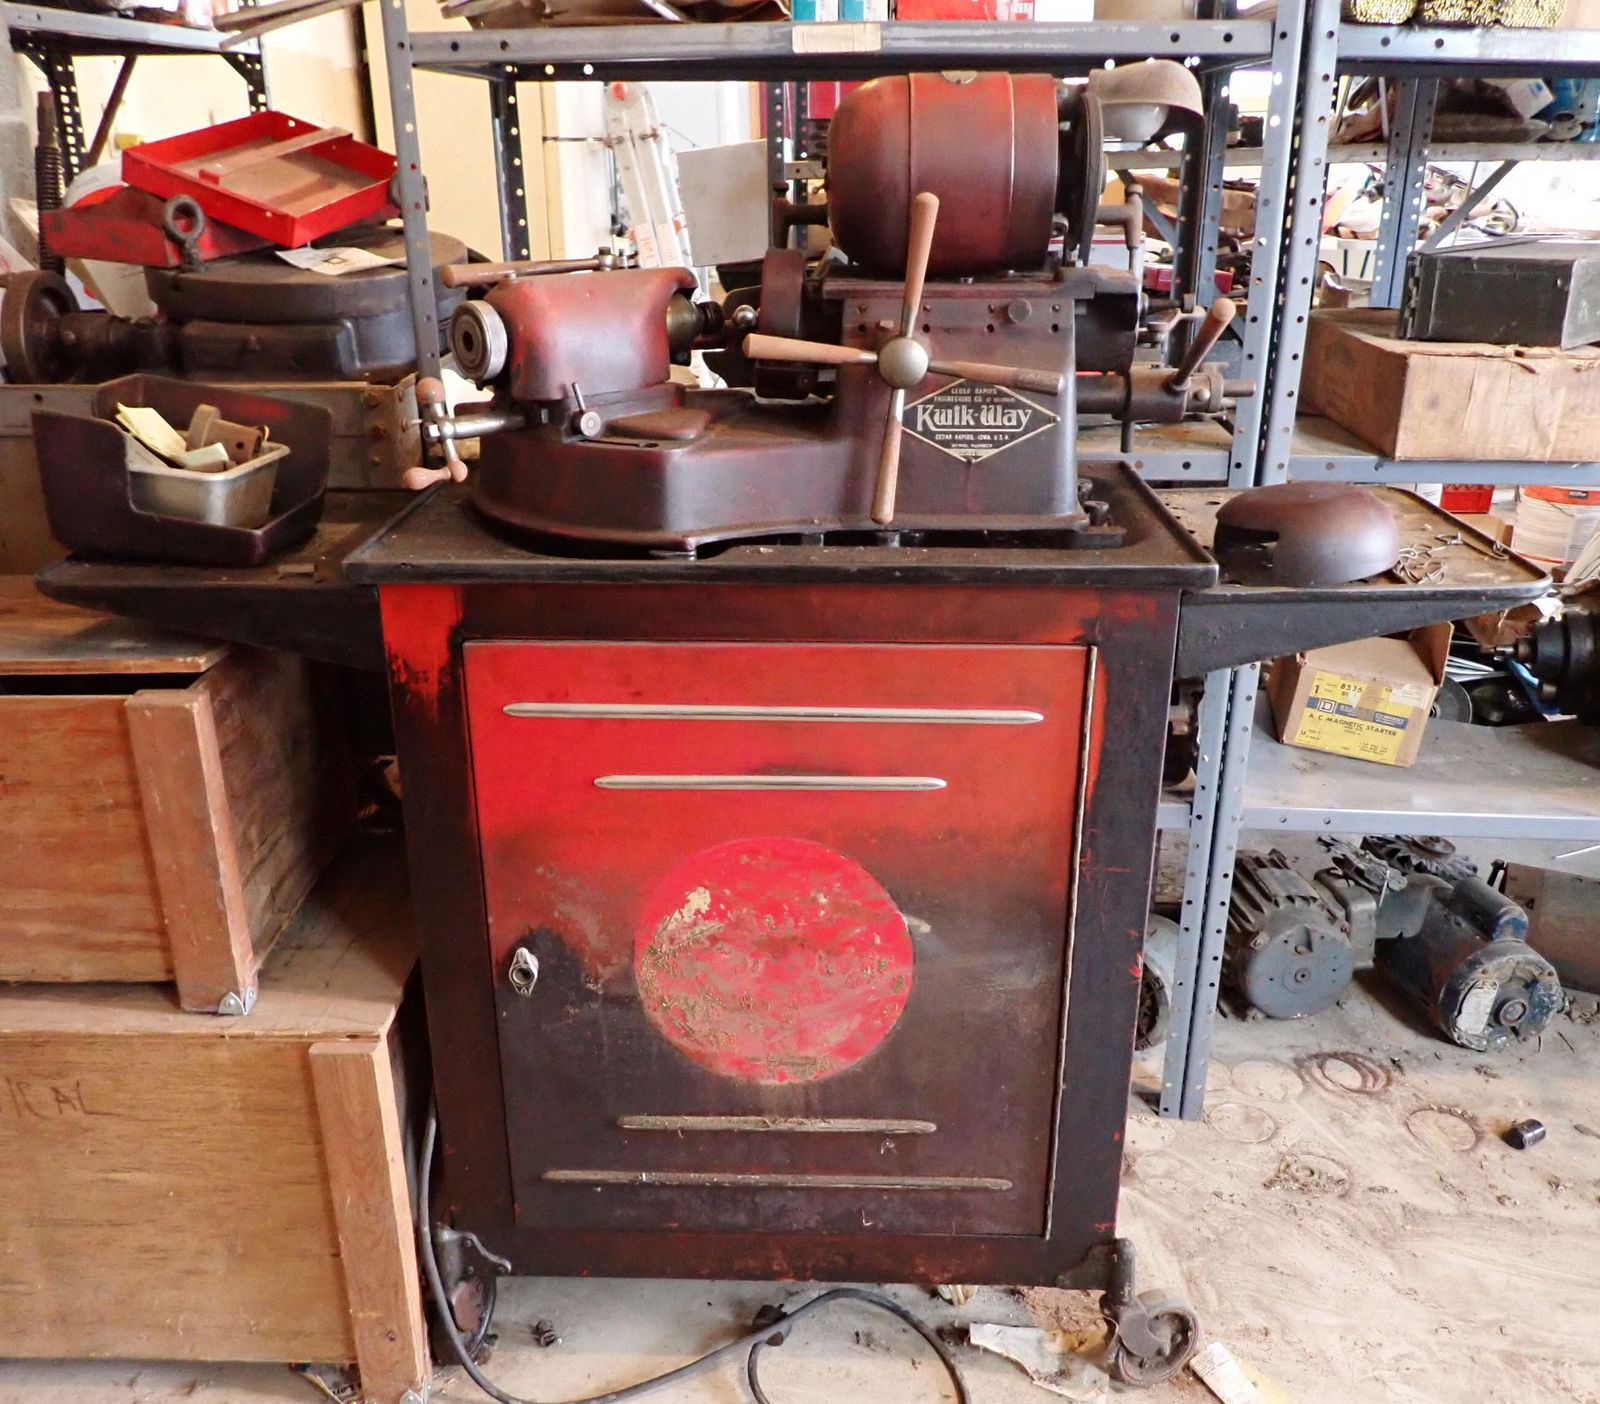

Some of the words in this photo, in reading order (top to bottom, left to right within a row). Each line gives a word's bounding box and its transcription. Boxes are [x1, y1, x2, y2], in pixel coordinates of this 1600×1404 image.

[916, 404, 1033, 432] Kwik-Way
[935, 433, 953, 441] CEDAR
[1340, 682, 1363, 693] 8536
[1325, 717, 1364, 729] MAGNETIC
[1365, 725, 1397, 737] STARTER
[6, 1076, 128, 1120] ICAL
